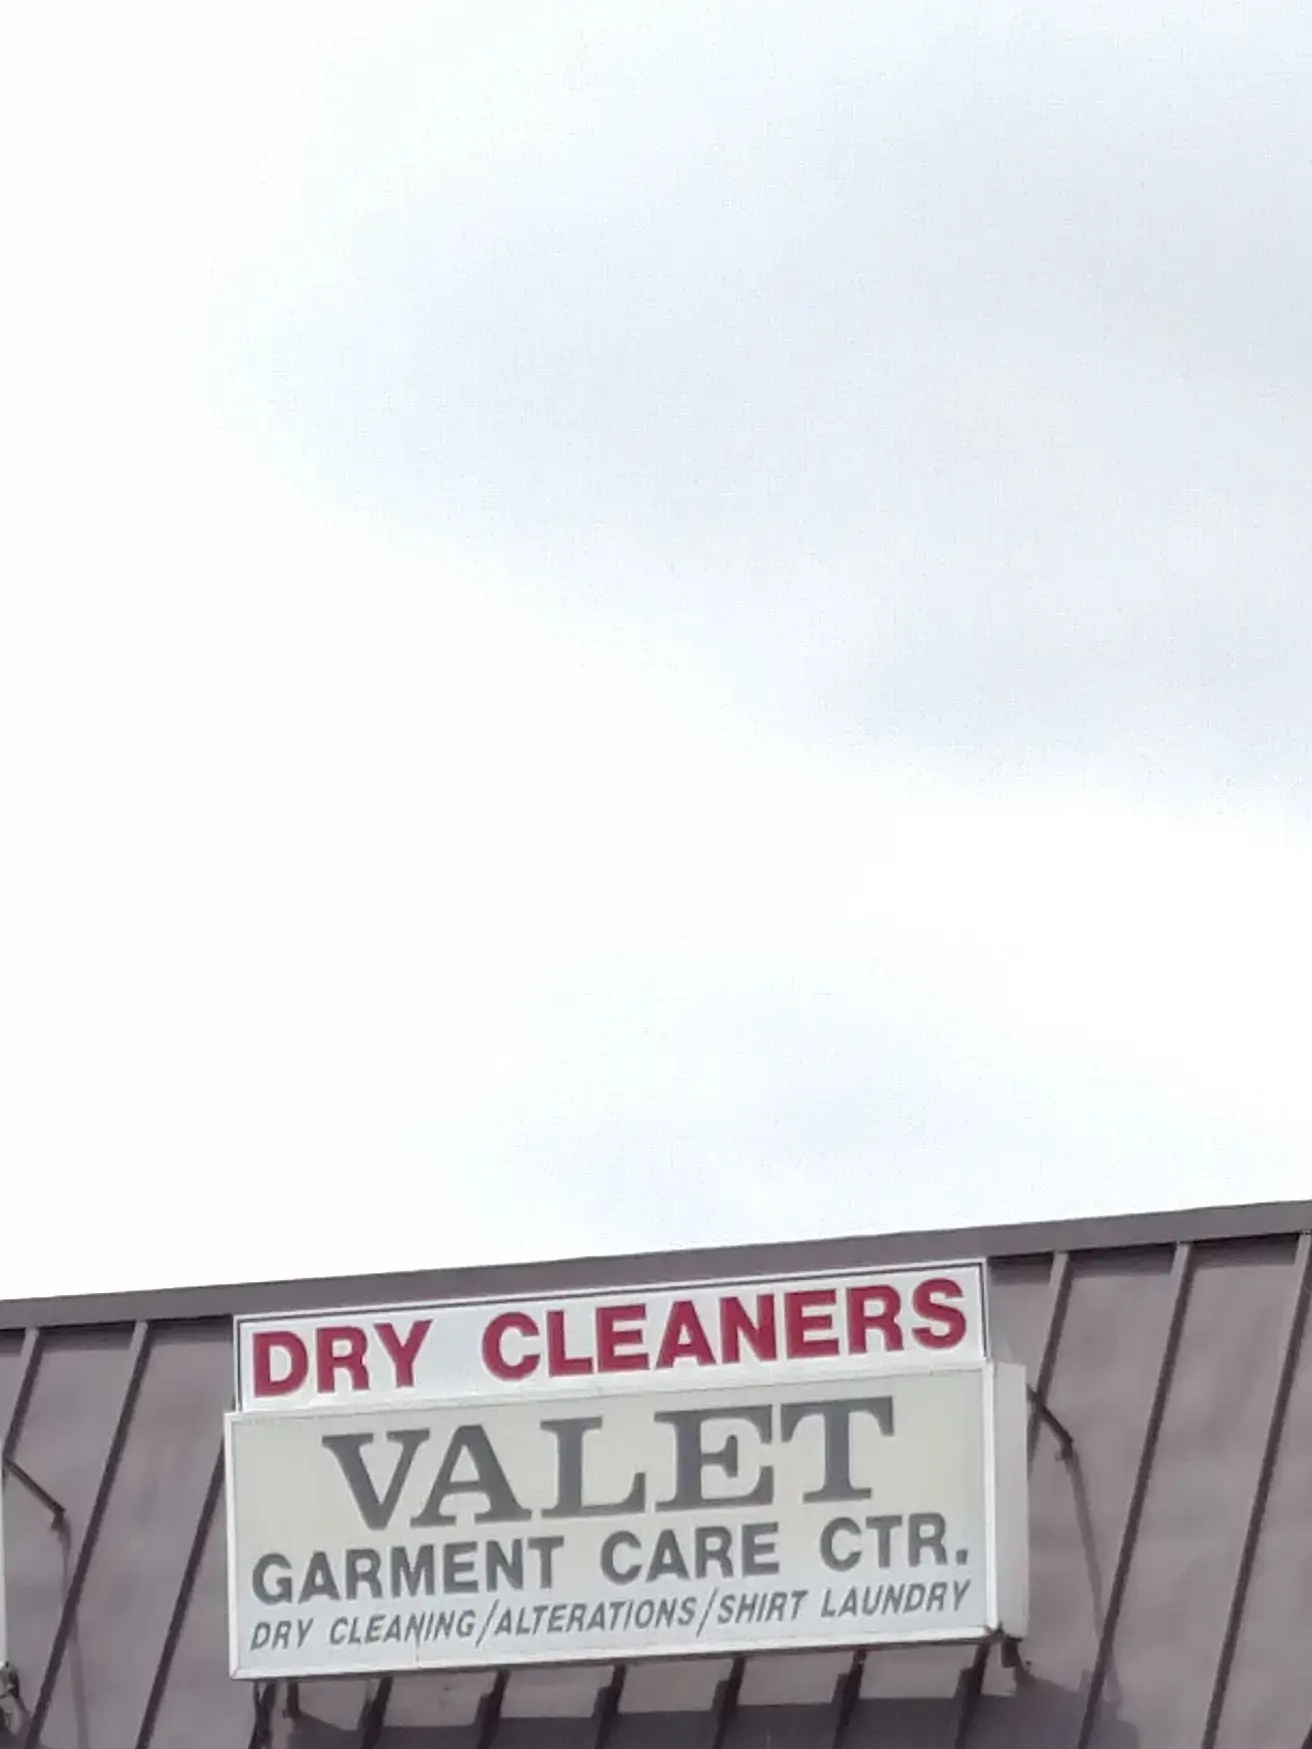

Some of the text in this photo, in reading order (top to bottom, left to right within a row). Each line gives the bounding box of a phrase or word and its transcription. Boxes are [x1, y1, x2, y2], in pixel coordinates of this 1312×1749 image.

[252, 1277, 968, 1398] DRY CLEANERS
[322, 1395, 894, 1530] VALET
[251, 1512, 970, 1605] GARMENT CARE CTR.
[249, 1617, 315, 1651] DRY
[820, 1579, 971, 1618] LAUNDRY
